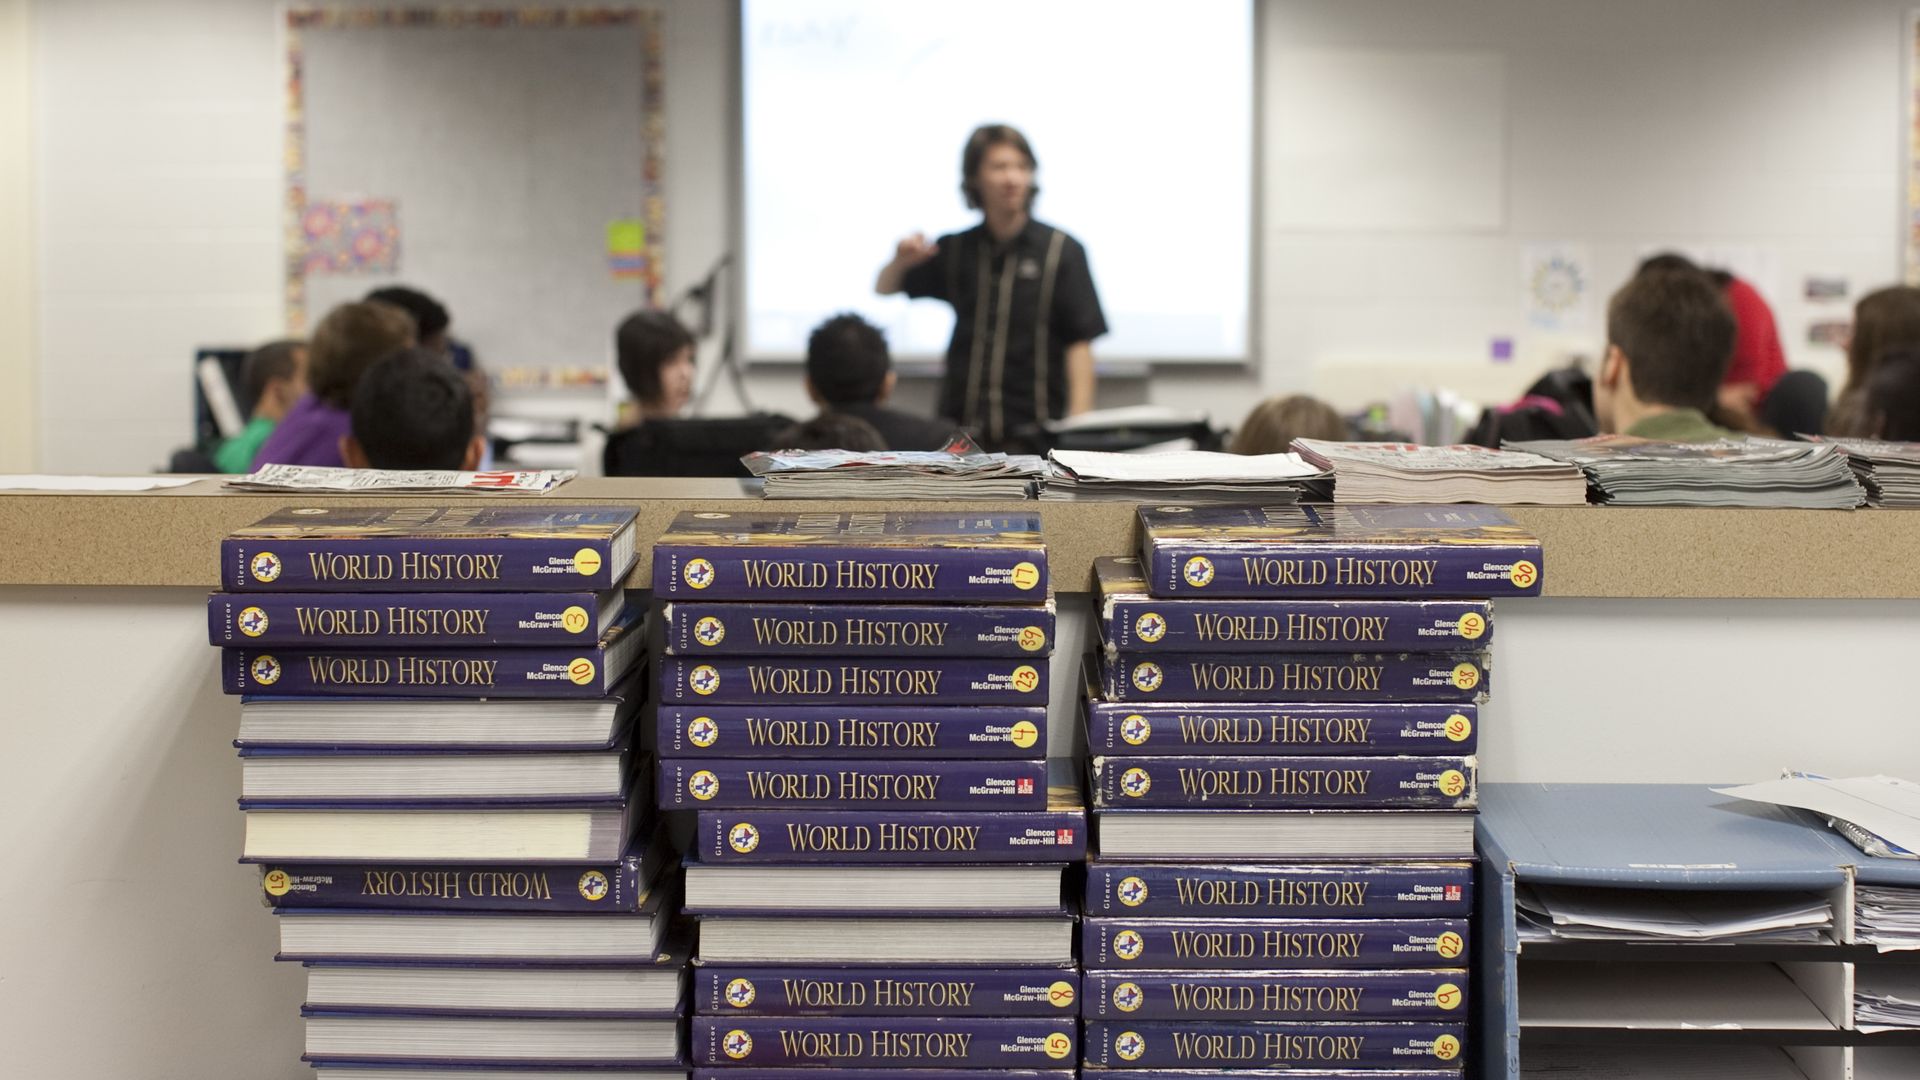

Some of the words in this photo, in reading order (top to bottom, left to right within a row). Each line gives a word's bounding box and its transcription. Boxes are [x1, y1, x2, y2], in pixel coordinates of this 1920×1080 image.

[309, 552, 392, 580] WORLD
[401, 553, 503, 580] HISTORY
[549, 557, 574, 565] Glenco
[743, 560, 827, 588] WORLD
[836, 561, 939, 589] HISTORY
[969, 576, 1014, 585] McGraw-Hil
[985, 567, 1014, 576] Glenco
[1016, 569, 1033, 584] 17
[1242, 557, 1327, 585] WORLD
[1335, 558, 1437, 585] HISTORY
[1513, 564, 1533, 583] 30
[296, 608, 378, 635] WORLD
[388, 608, 489, 635] HISTORY
[519, 620, 565, 628] McGraw-Hil
[566, 613, 585, 626] 3
[1195, 614, 1279, 641] WORLD
[1287, 614, 1389, 641] HISTORY
[1463, 618, 1480, 637] 40
[753, 618, 838, 645] WORLD
[846, 619, 948, 646] HISTORY
[1020, 630, 1041, 647] 39
[309, 657, 390, 684] WORLD
[398, 657, 498, 684] HISTORY
[542, 664, 569, 672] Glenco
[573, 664, 590, 681] 10
[1192, 663, 1274, 690] WORLD
[1282, 664, 1383, 691] HISTORY
[1429, 669, 1454, 677] Glenco
[748, 666, 832, 694] WORLD
[840, 667, 942, 695] HISTORY
[1016, 671, 1036, 687] 23
[1457, 669, 1476, 688] 38
[746, 718, 830, 746] WORLD
[839, 719, 940, 747] HISTORY
[985, 726, 1013, 734] Glenco
[1014, 728, 1036, 741] 4
[1178, 716, 1262, 743] WORLD
[1270, 716, 1371, 744] HISTORY
[1448, 720, 1464, 736] 16
[969, 734, 1014, 742] McGraw-Hil
[747, 772, 830, 799] WORLD
[838, 772, 940, 800] HISTORY
[986, 778, 1015, 786] Glencoe
[1180, 769, 1262, 794] WORLD
[1270, 769, 1370, 794] HISTORY
[1415, 773, 1441, 781] Glenco
[1447, 775, 1462, 794] 36
[969, 786, 1015, 794] McGraw-Hill
[787, 824, 870, 851] WORLD
[879, 824, 980, 851] HISTORY
[1009, 837, 1056, 845] McGraw-Hill
[1025, 829, 1056, 837] Glencoe
[269, 872, 284, 891] 37
[362, 872, 460, 898] HISTORY
[469, 873, 552, 900] WORLD
[1414, 885, 1444, 893] Glencoe
[1176, 878, 1259, 905] WORLD
[1267, 878, 1368, 905] HISTORY
[1398, 893, 1444, 901] McGraw-Hill
[1172, 931, 1255, 957] WORLD
[1263, 931, 1364, 958] HISTORY
[1440, 935, 1460, 956] 22
[783, 979, 866, 1006] WORLD
[874, 980, 974, 1006] HISTORY
[1050, 988, 1075, 1000] 8
[1171, 984, 1254, 1010] WORLD
[1262, 985, 1363, 1011] HISTORY
[1438, 989, 1459, 1004] 9
[781, 1030, 863, 1057] WORLD
[871, 1031, 971, 1058] HISTORY
[1017, 1036, 1046, 1044] Glencoe
[1050, 1038, 1068, 1054] 15
[1173, 1033, 1255, 1059] WORLD
[1263, 1033, 1364, 1060] HISTORY
[1436, 1041, 1454, 1058] 35
